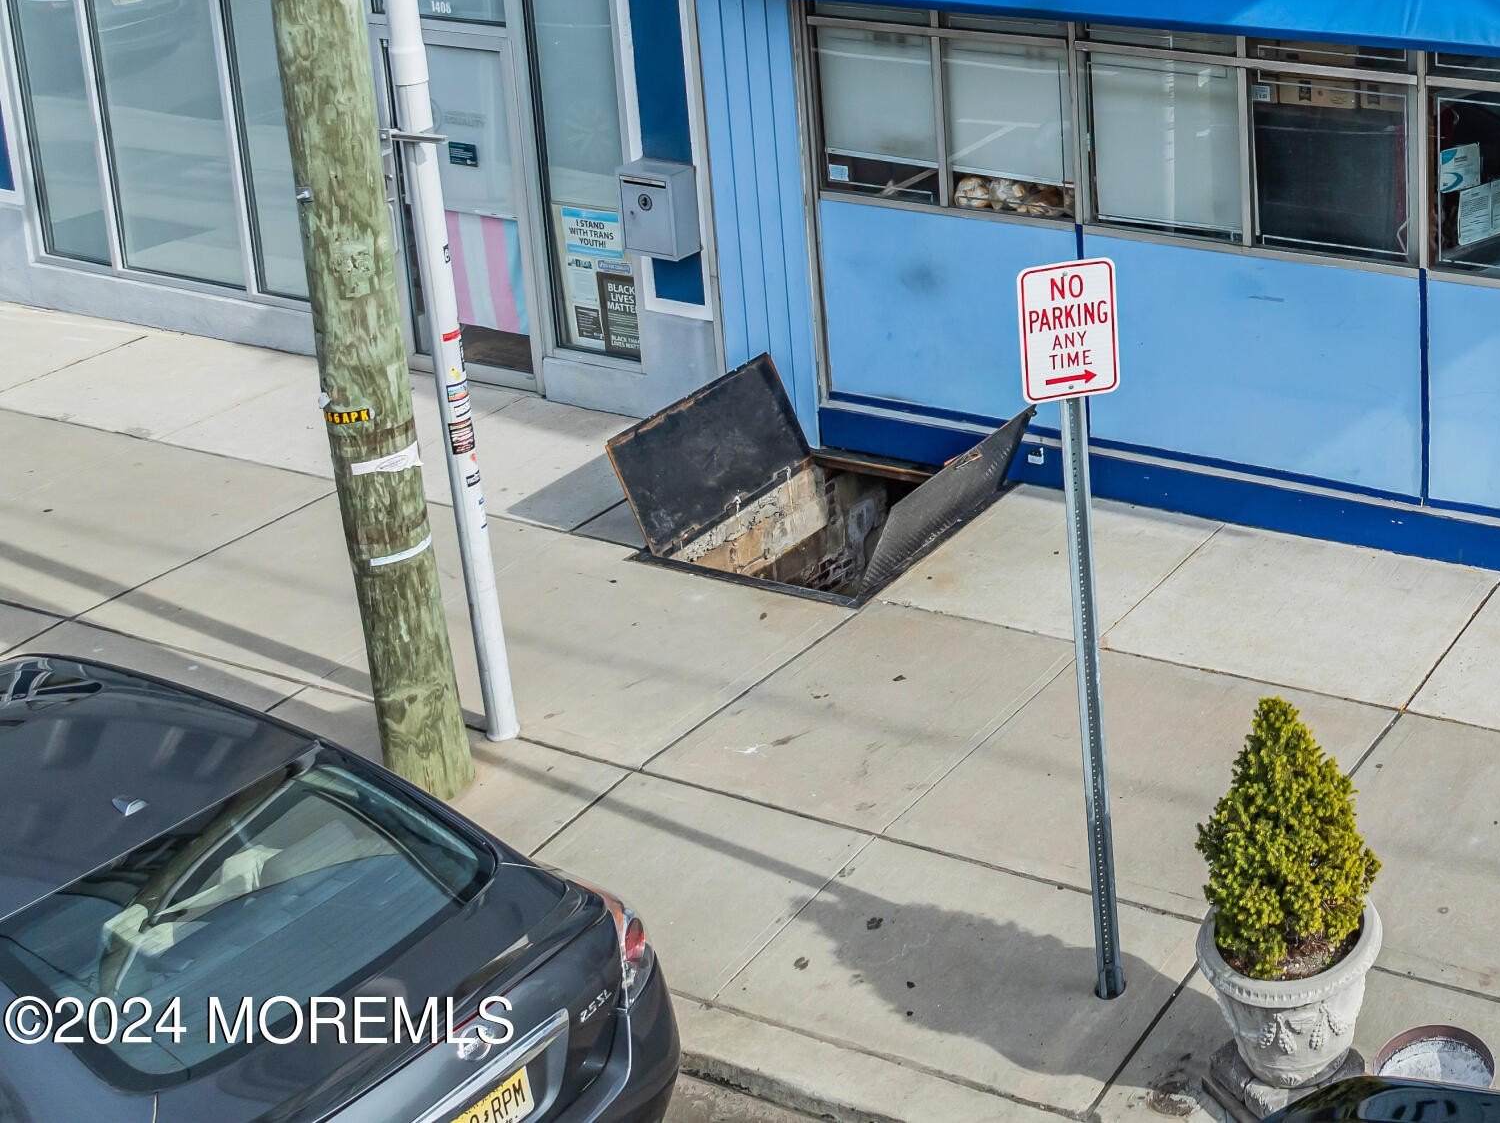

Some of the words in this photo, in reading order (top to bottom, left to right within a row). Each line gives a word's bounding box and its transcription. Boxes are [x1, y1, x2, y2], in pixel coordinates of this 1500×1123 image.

[430, 0, 452, 14] 1408
[581, 220, 605, 230] STAND
[569, 227, 588, 237] WITH
[589, 230, 614, 240] TRANS
[579, 237, 607, 248] YOUTH!
[607, 283, 635, 295] BLACK
[1050, 274, 1084, 301] NO
[611, 293, 634, 303] LIVES
[607, 301, 637, 314] MATTE
[1029, 300, 1108, 334] PARKING
[1052, 330, 1087, 350] ANY
[1049, 349, 1092, 370] TIME
